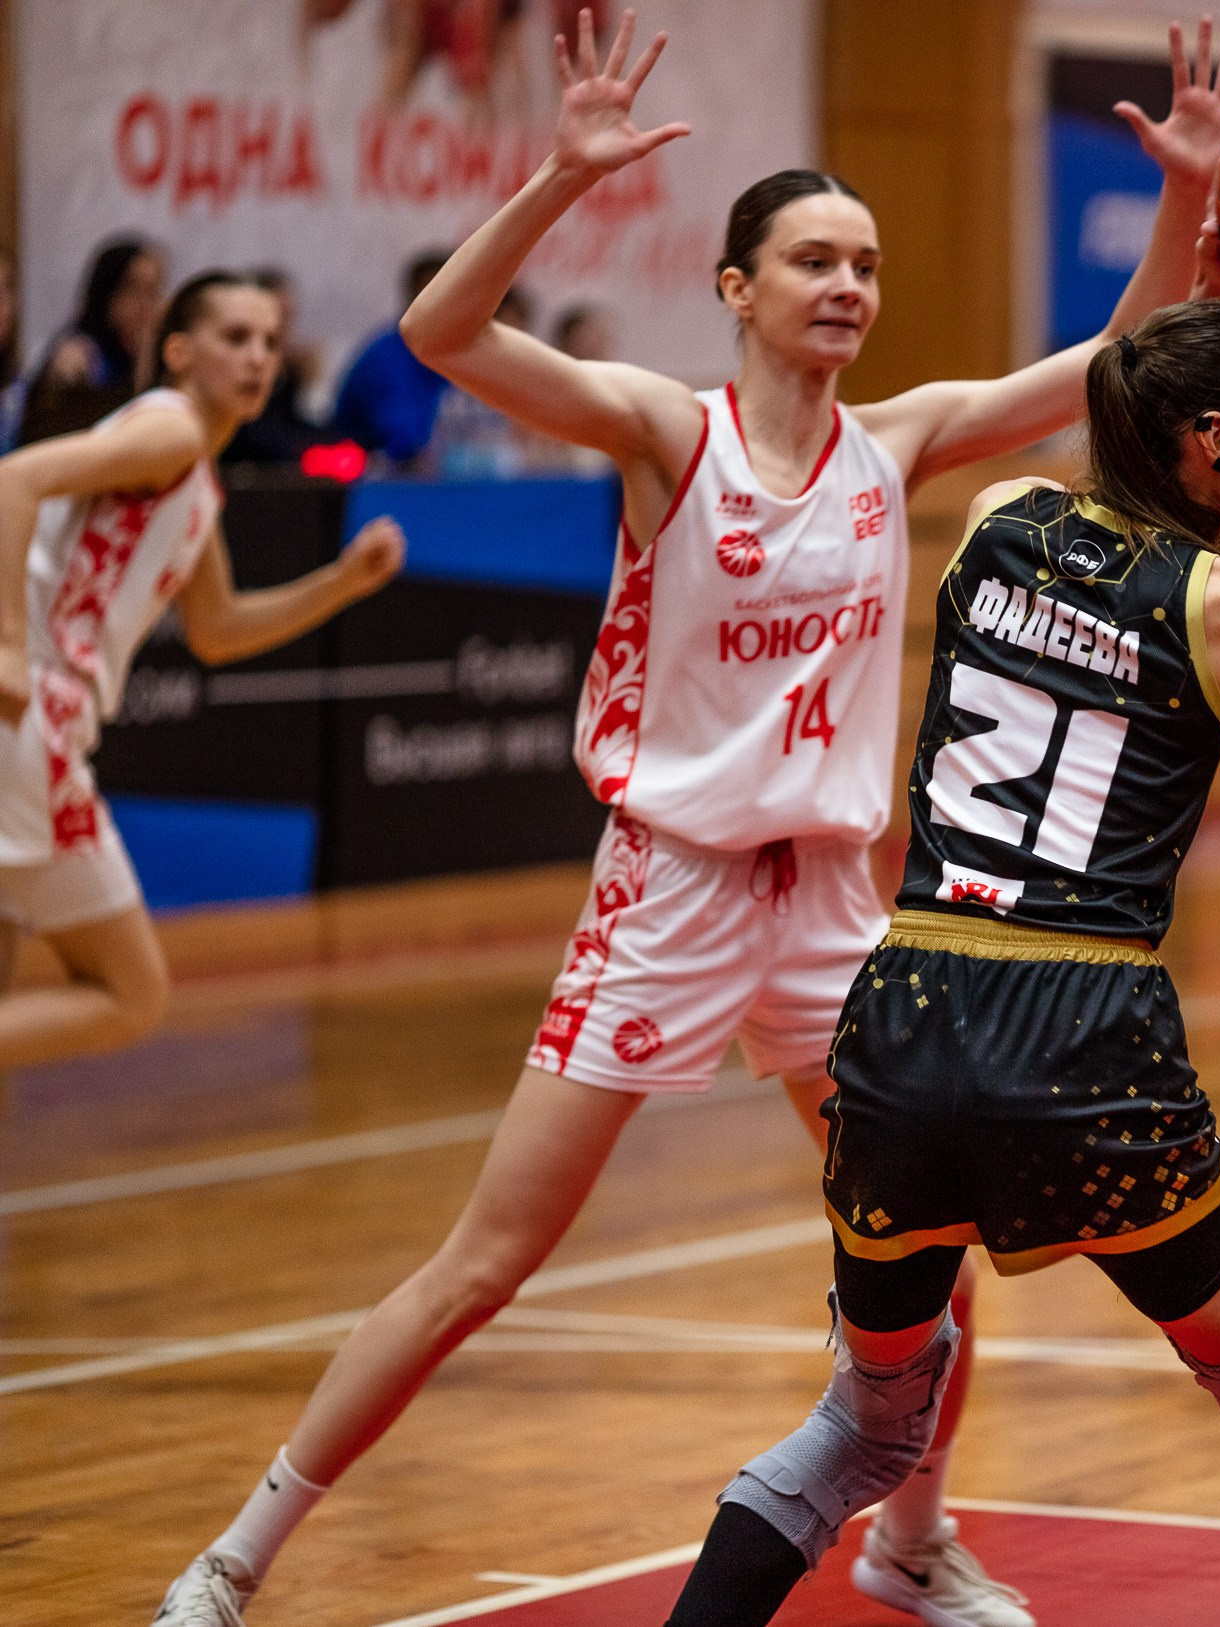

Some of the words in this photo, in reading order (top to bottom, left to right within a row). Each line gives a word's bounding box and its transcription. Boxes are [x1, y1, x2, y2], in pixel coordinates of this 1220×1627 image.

[115, 93, 322, 213] ОДНА
[968, 576, 1141, 685] ФАДЕЕВА
[782, 676, 836, 757] 14
[925, 661, 1131, 874] 21
